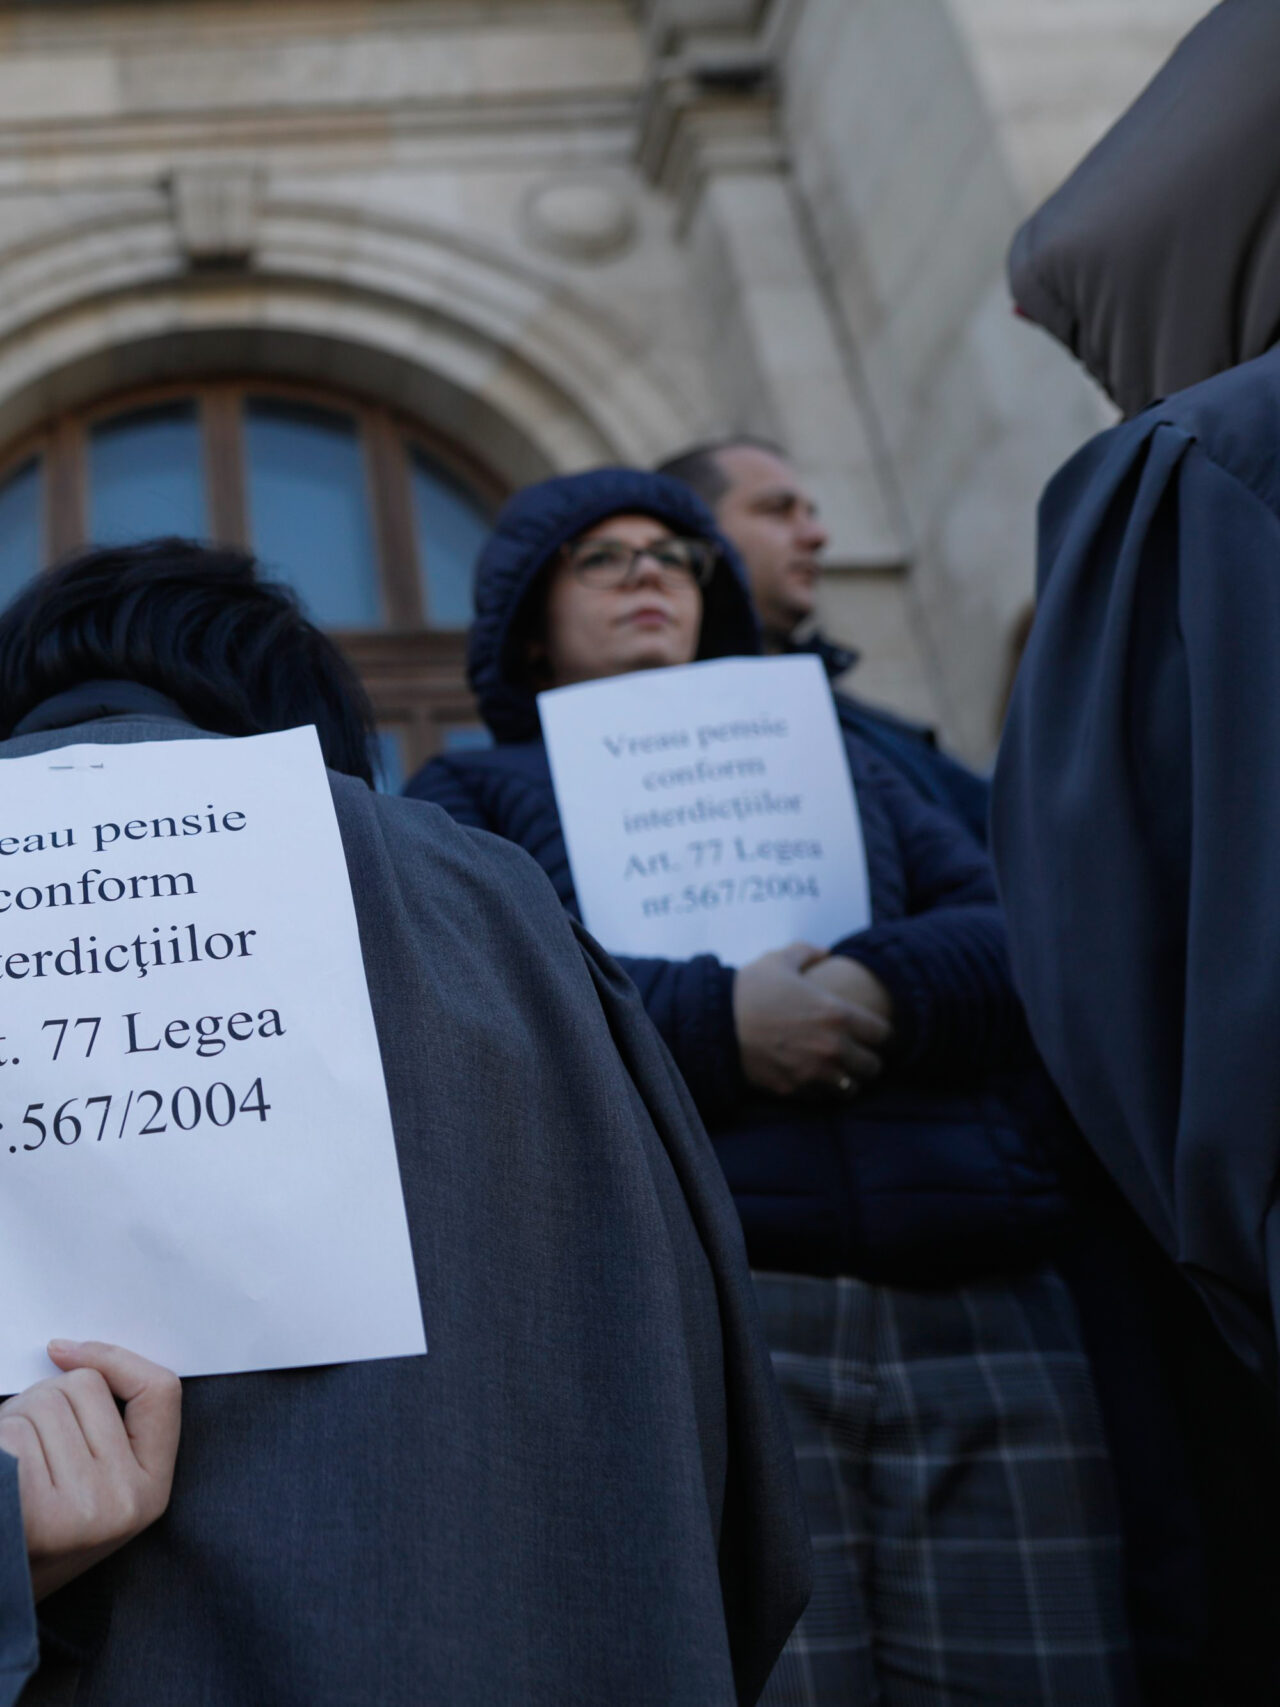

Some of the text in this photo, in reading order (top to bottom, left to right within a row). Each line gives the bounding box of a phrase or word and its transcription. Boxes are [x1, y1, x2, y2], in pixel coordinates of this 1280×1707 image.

[602, 717, 788, 757] Vreau pensie
[643, 757, 766, 791] conform
[92, 804, 247, 852] pensie
[688, 838, 723, 866] 77
[734, 836, 824, 862] Legea
[642, 874, 819, 917] nr.567/2004
[41, 1017, 102, 1061] 77
[122, 1006, 287, 1057] Legea
